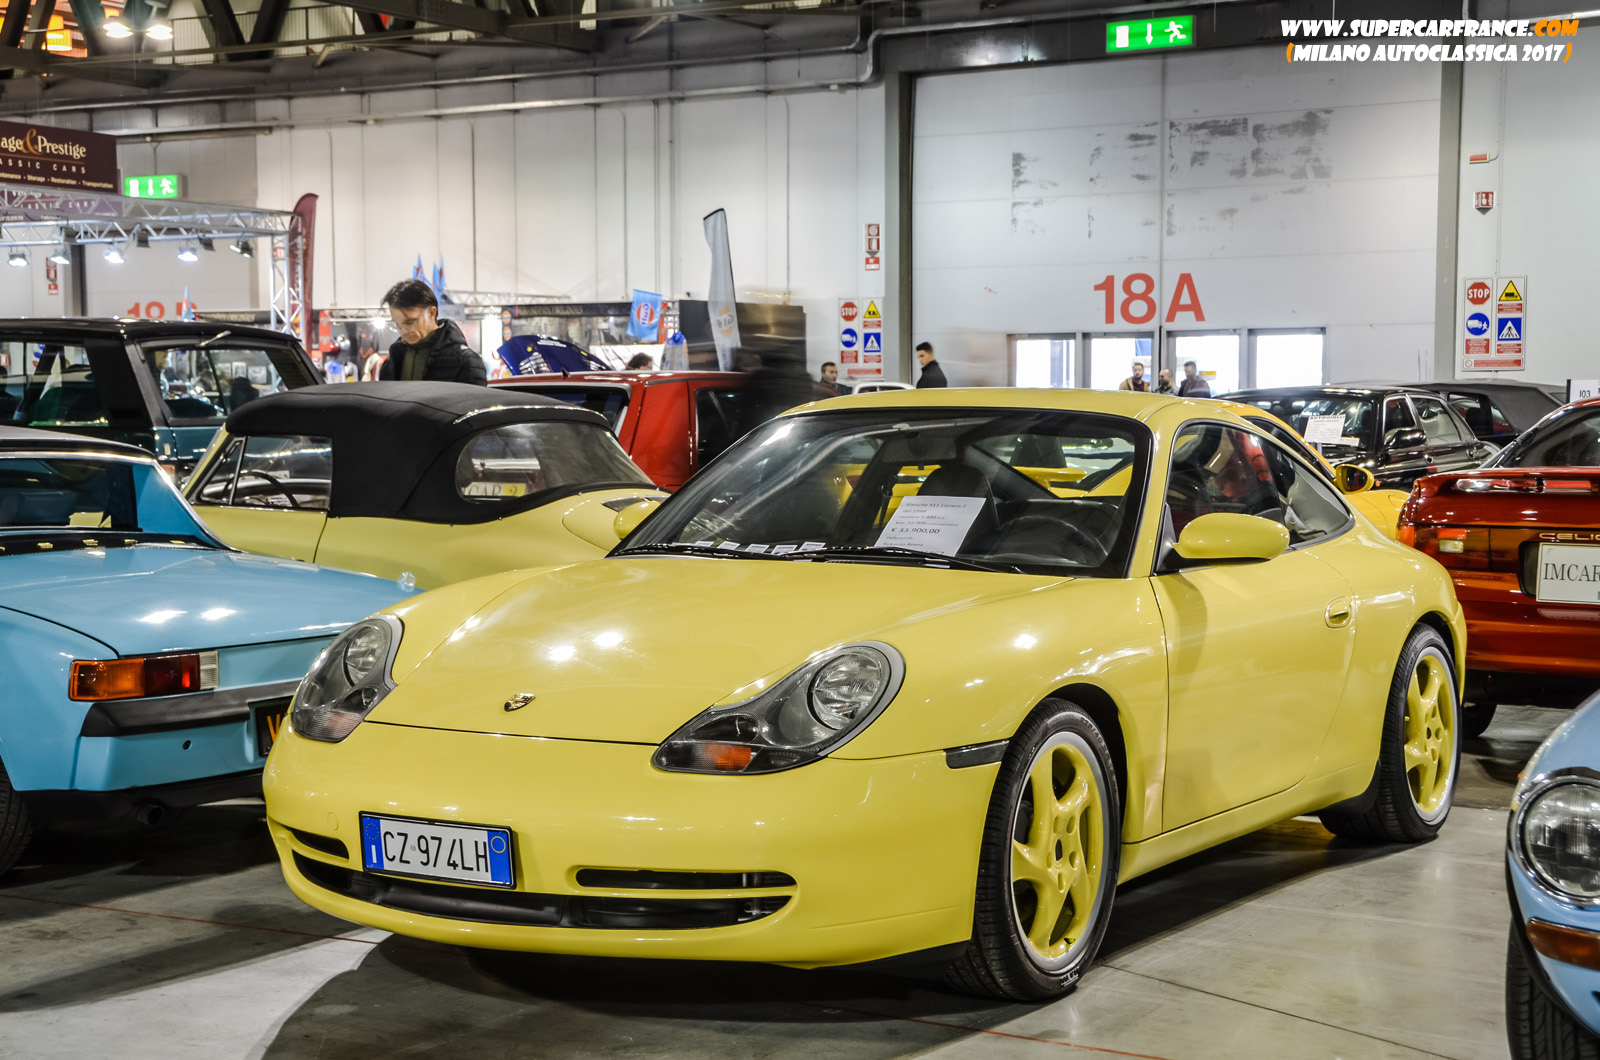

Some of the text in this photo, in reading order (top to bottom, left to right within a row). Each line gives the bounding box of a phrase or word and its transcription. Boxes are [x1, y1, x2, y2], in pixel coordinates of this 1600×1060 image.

[37, 135, 87, 159] Prestige
[53, 164, 85, 174] CARS
[1093, 272, 1206, 325] 18 A
[1468, 288, 1490, 299] STOP
[841, 307, 857, 317] STOP
